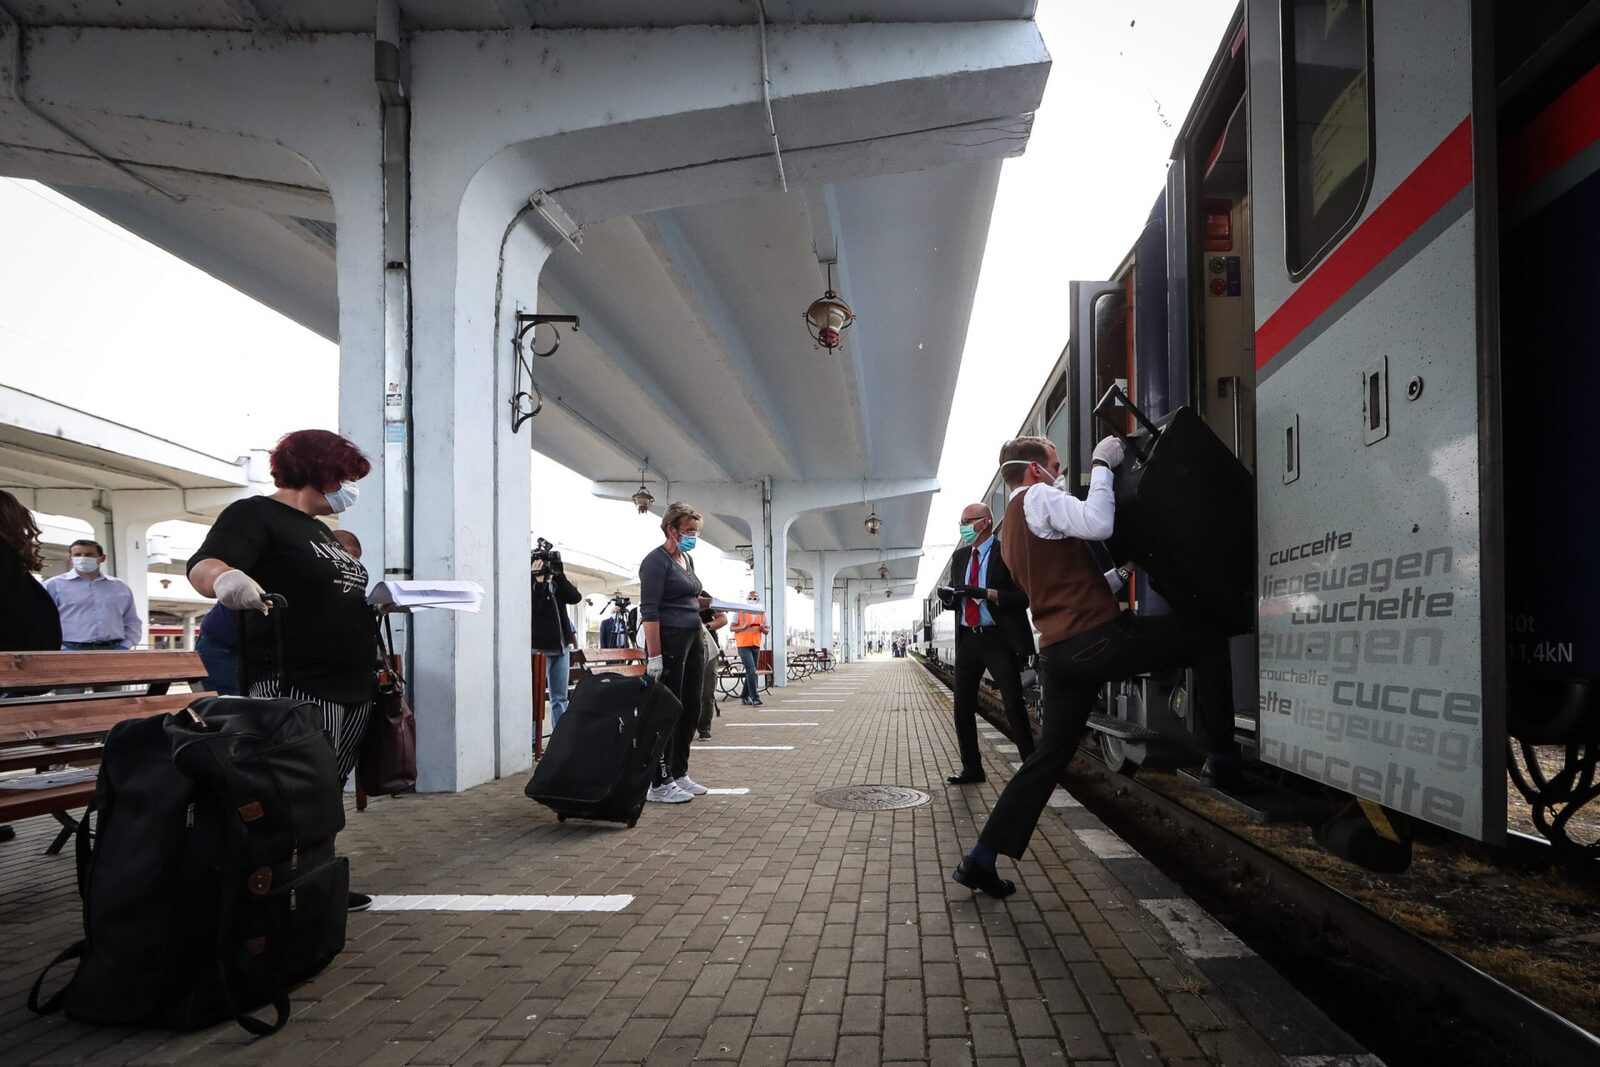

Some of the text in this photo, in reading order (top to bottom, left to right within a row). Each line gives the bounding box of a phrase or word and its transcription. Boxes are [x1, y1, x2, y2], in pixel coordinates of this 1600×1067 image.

[1269, 530, 1353, 566] cuccette
[1291, 586, 1454, 626] couchette
[1260, 667, 1329, 687] couchette
[1332, 680, 1482, 726] cucce
[1293, 697, 1483, 773] liegewag
[1260, 737, 1466, 831] cuccette
